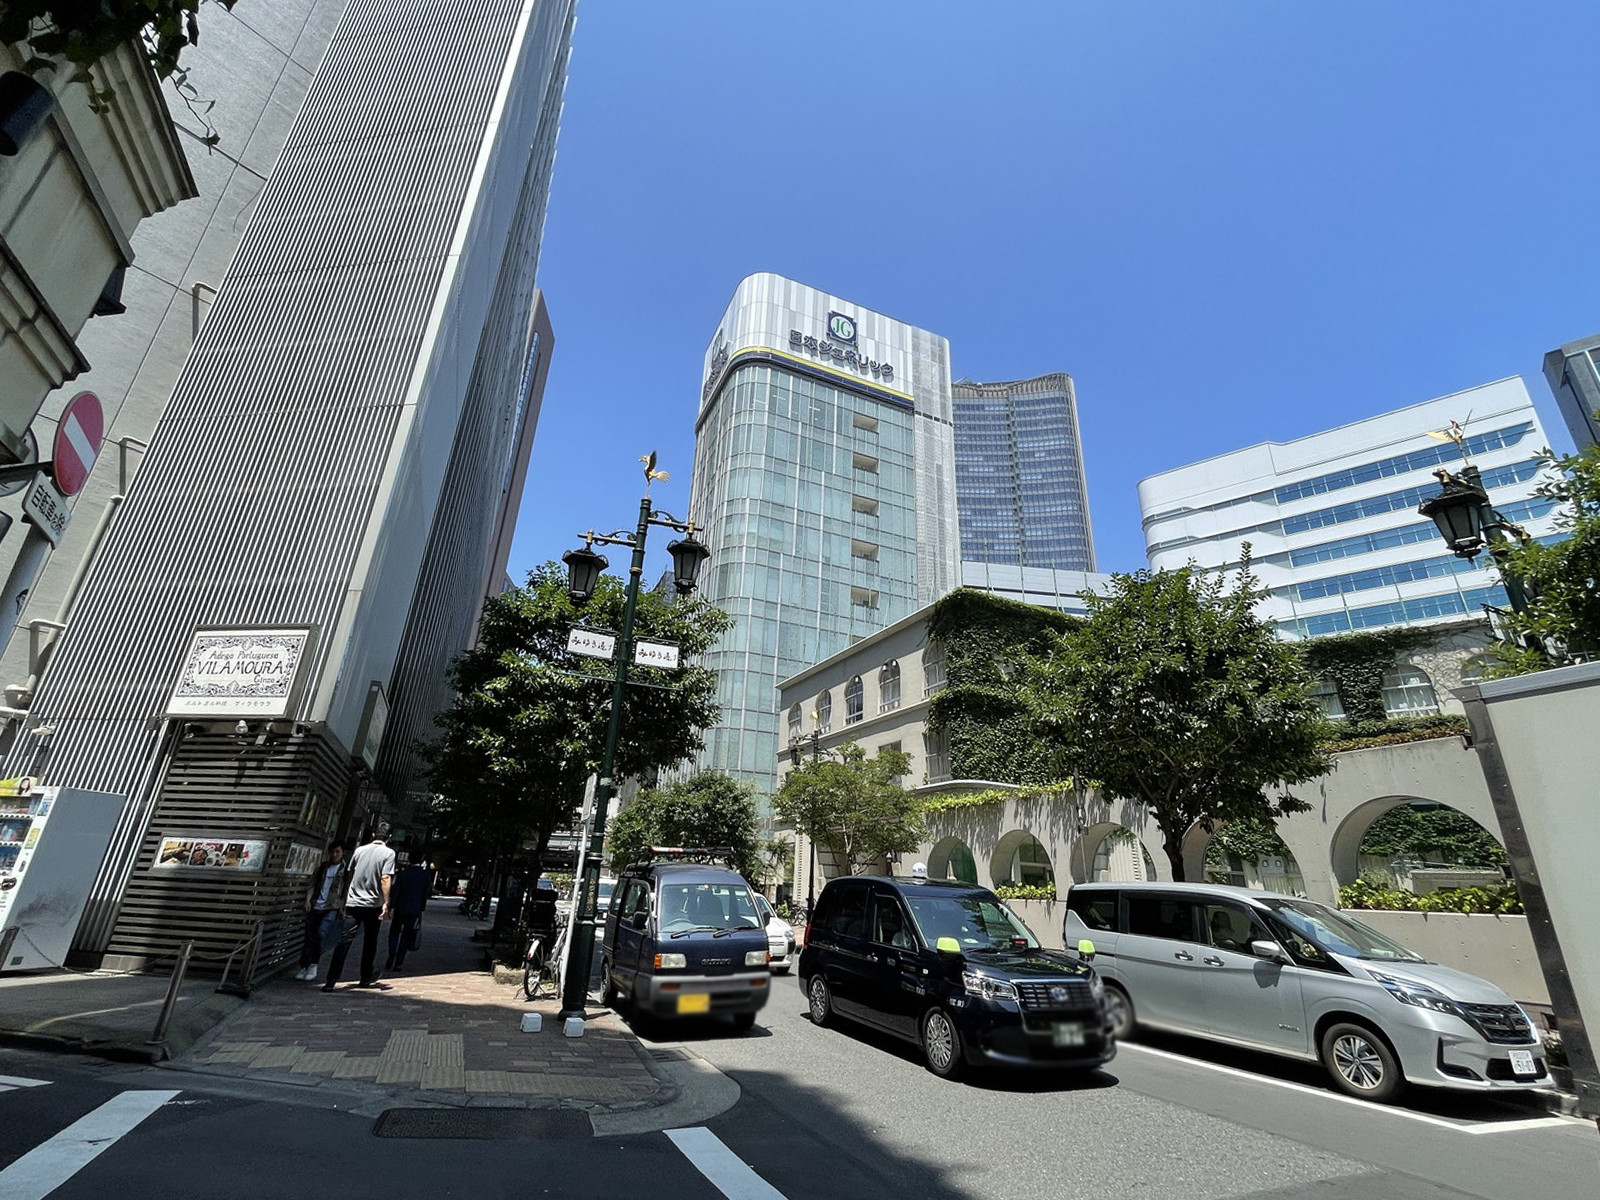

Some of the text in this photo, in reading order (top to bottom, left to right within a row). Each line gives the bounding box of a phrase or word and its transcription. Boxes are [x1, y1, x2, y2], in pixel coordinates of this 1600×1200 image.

[832, 316, 852, 338] JG
[788, 329, 894, 375] 日本ジェネリック
[198, 660, 283, 675] VILAMOURA
